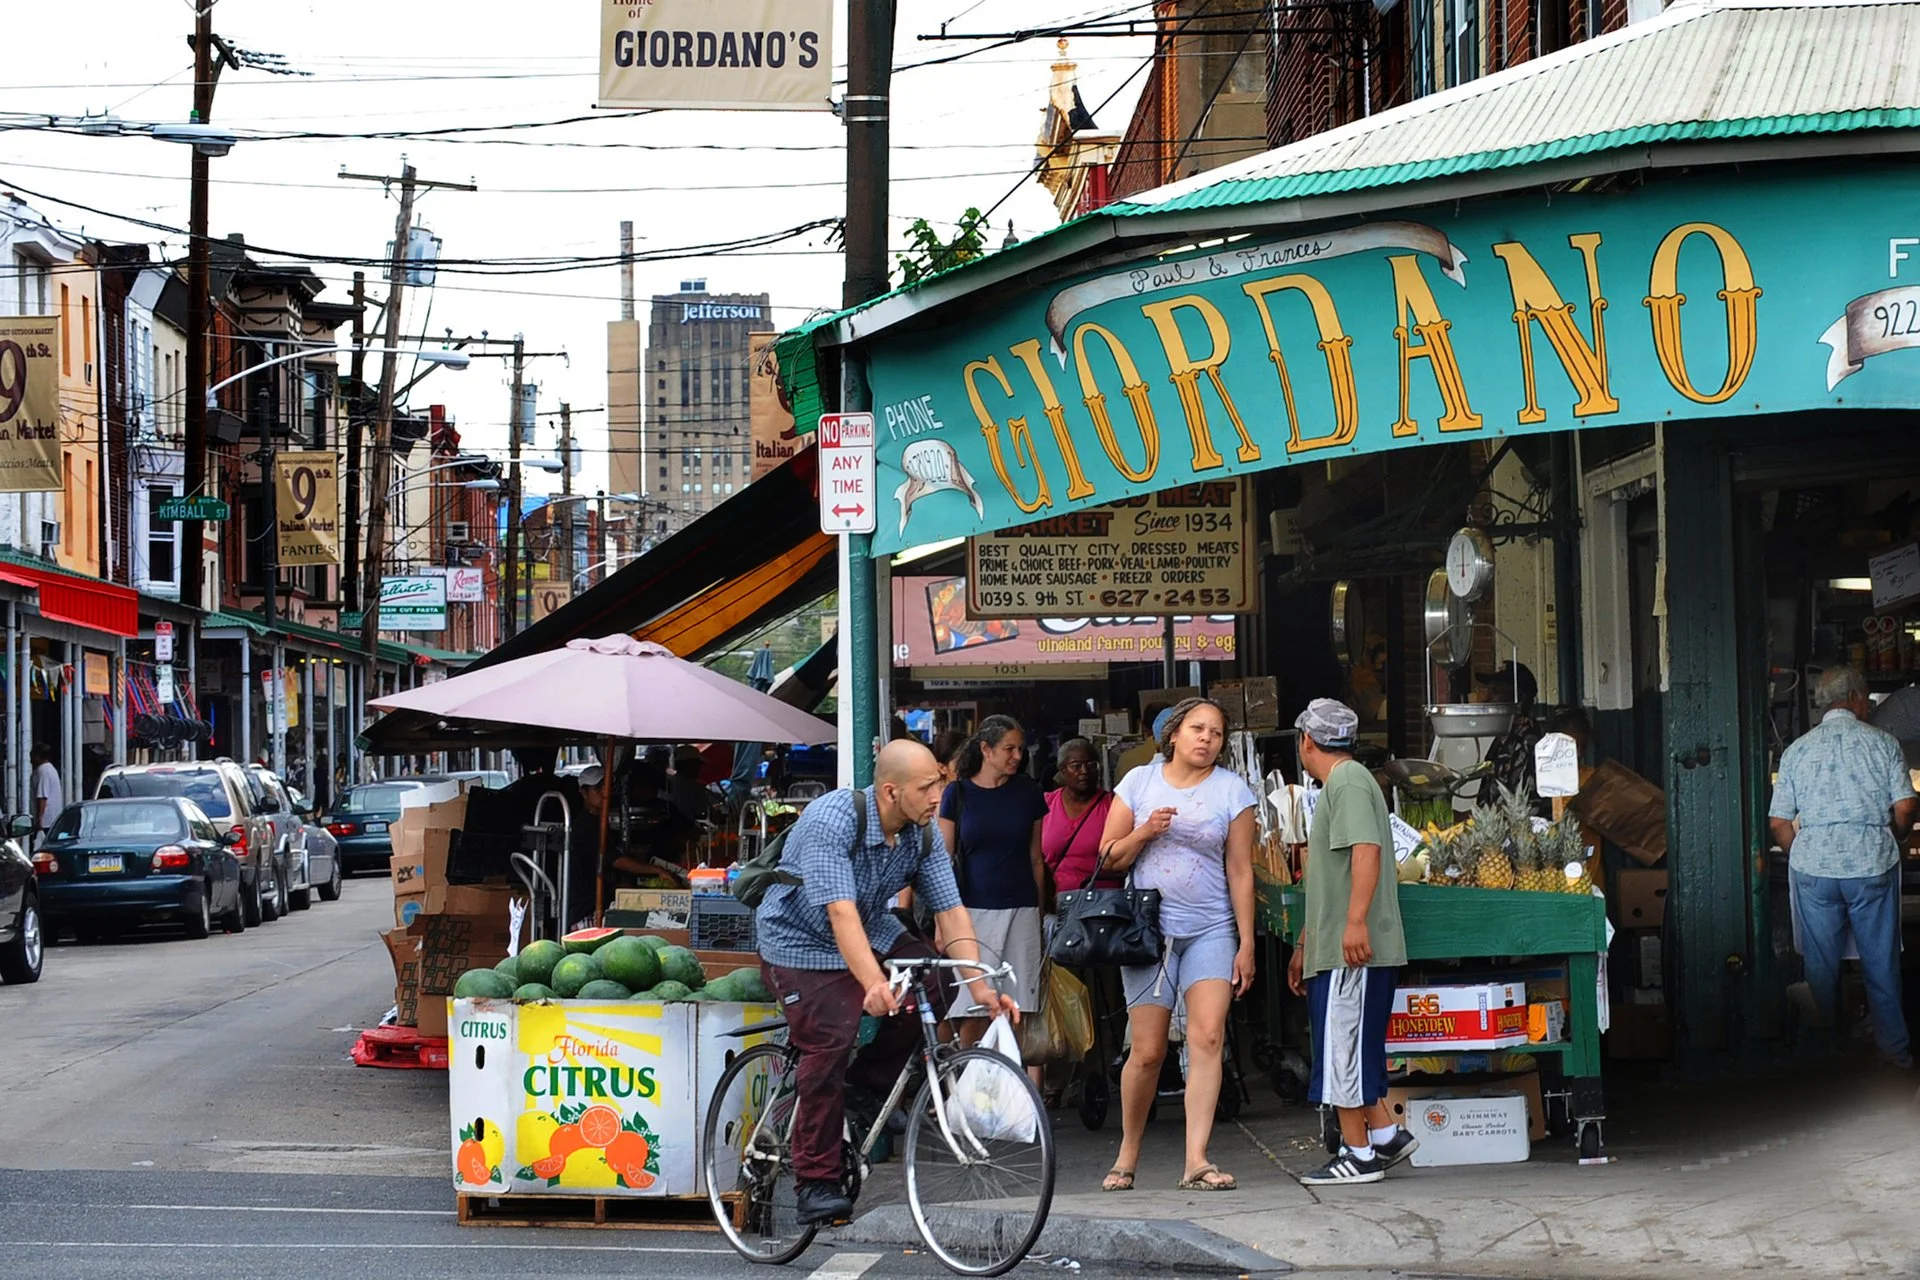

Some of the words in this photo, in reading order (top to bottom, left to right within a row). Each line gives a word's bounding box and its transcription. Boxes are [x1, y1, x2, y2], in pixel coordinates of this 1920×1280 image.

[628, 7, 643, 19] of
[615, 30, 819, 69] GIORDANO'S
[1130, 263, 1195, 292] Paul
[1209, 257, 1228, 277] &
[1237, 238, 1333, 270] Frances
[962, 220, 1764, 514] GIORDANO
[885, 395, 944, 440] PHONE
[16, 418, 56, 440] Market
[822, 420, 839, 444] NO
[841, 423, 871, 439] PARKING
[756, 440, 794, 459] Italian
[832, 456, 863, 471] ANY
[832, 478, 864, 494] TIME
[1157, 482, 1237, 508] MEAT
[159, 505, 207, 518] KIMBALL
[216, 508, 226, 518] ST
[1134, 509, 1180, 536] Since
[1185, 512, 1233, 533] 1934
[281, 543, 336, 556] FANTE'S
[979, 544, 1010, 557] BEST
[1019, 543, 1078, 558] QUALITY
[1087, 543, 1120, 556] CITY
[1131, 542, 1187, 556] DRESSED
[1197, 541, 1240, 555] MEATS
[980, 559, 1009, 573] PRIME
[1019, 558, 1054, 572] CHOICE
[979, 573, 1008, 586] HOME
[1011, 572, 1042, 586] MADE
[1046, 572, 1098, 585] SAUSAGE
[1113, 571, 1152, 584] FREEZR
[1161, 570, 1206, 583] ORDERS
[980, 591, 1013, 607] 1039
[1017, 591, 1028, 606] S.
[1035, 590, 1058, 606] 9th
[1065, 589, 1085, 606] ST.
[1097, 635, 1134, 651] farm
[1139, 636, 1192, 654] poury
[1197, 633, 1208, 648] &
[1215, 636, 1236, 654] eg
[992, 665, 1028, 675] 1031
[461, 1020, 507, 1040] CITRUS
[1393, 1017, 1456, 1036] HONEYDEW
[548, 1035, 619, 1064] Florida
[524, 1065, 656, 1098] CITRUS
[1460, 1112, 1508, 1120] GRIMMWAY
[1478, 1128, 1518, 1136] CARROTS
